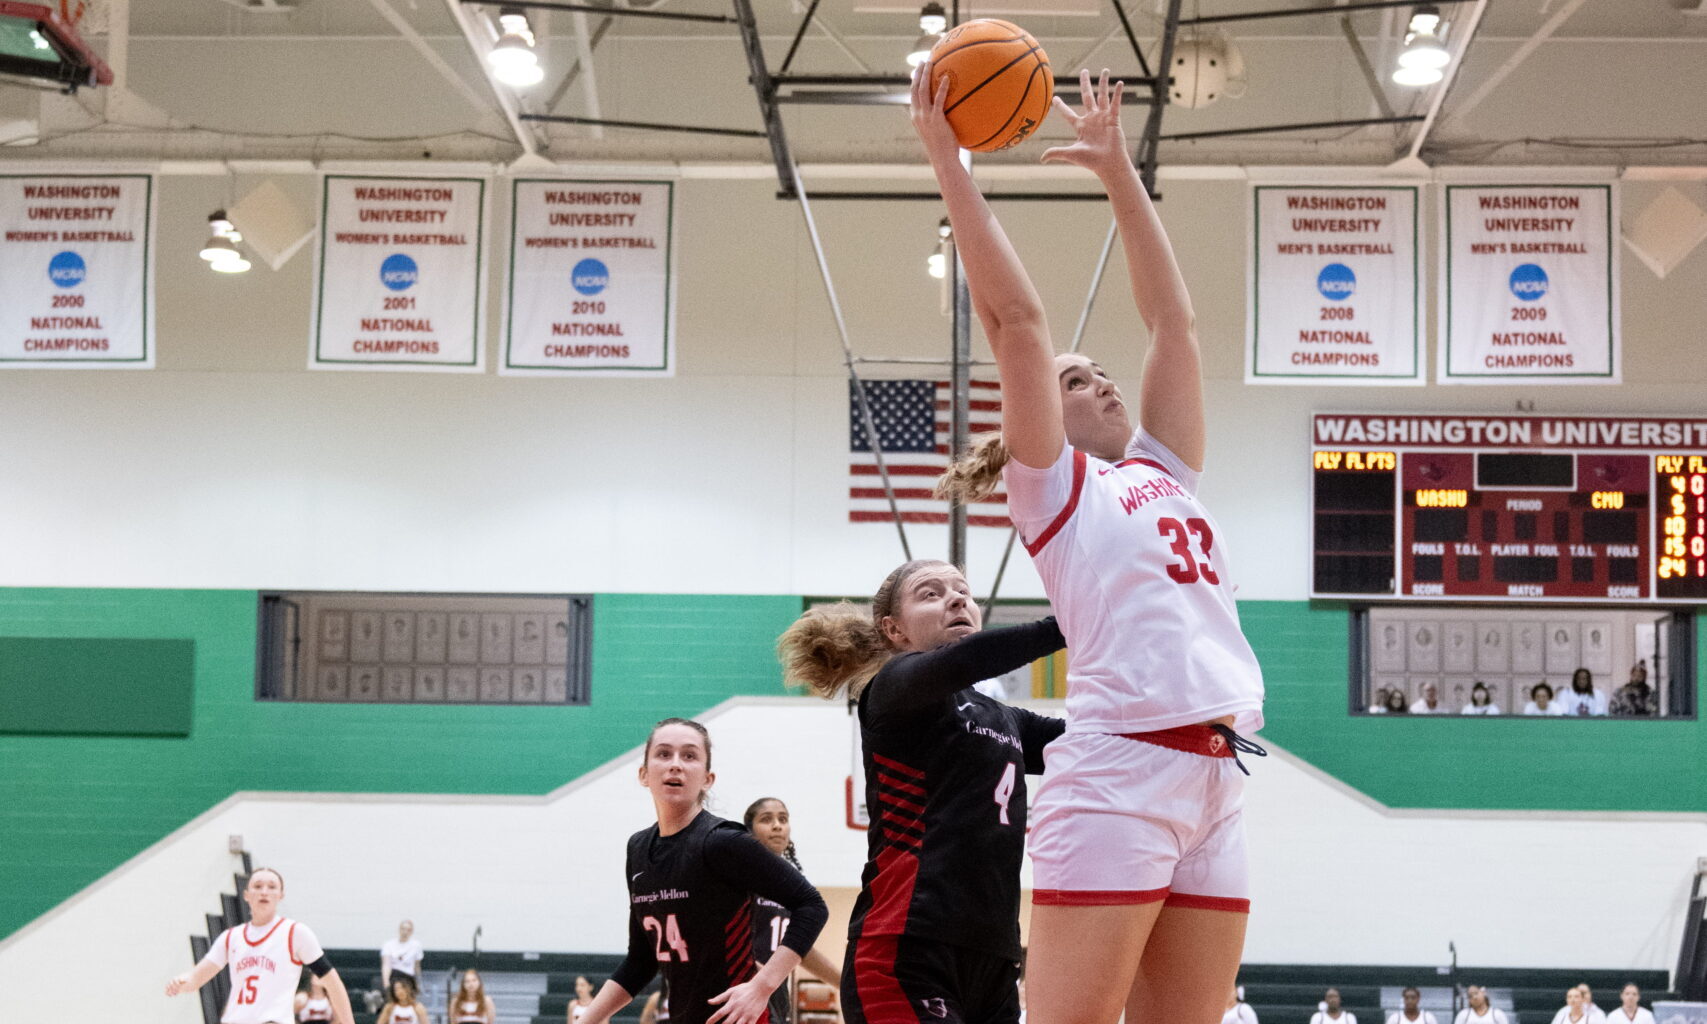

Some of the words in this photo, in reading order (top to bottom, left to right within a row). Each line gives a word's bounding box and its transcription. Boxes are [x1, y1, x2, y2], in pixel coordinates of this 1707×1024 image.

[23, 185, 122, 199] WASHINGTON
[354, 187, 452, 200] WASHINGTON
[544, 192, 641, 204] WASHINGTON
[1287, 197, 1386, 209] WASHINGTON
[1479, 196, 1580, 208] WASHINGTON
[27, 206, 115, 220] UNIVERSITY
[359, 209, 446, 222] UNIVERSITY
[549, 212, 635, 226] UNIVERSITY
[1292, 218, 1381, 232] UNIVERSITY
[1484, 217, 1575, 232] UNIVERSITY
[5, 231, 58, 241] WOMEN'S
[61, 230, 134, 242] BASKETBALL
[336, 232, 390, 244] WOMEN'S
[392, 233, 466, 245] BASKETBALL
[524, 237, 580, 248] WOMEN'S
[582, 237, 655, 248] BASKETBALL
[1276, 243, 1313, 254] MEN'S
[1317, 243, 1392, 255] BASKETBALL
[1471, 242, 1506, 254] MEN'S
[1509, 241, 1588, 254] BASKETBALL
[52, 296, 84, 308] 2000
[384, 297, 416, 310] 2001
[571, 301, 606, 315] 2010
[1320, 307, 1354, 320] 2008
[1511, 307, 1547, 320] 2009
[31, 317, 100, 329] NATIONAL
[360, 318, 432, 332] NATIONAL
[551, 323, 622, 336] NATIONAL
[1299, 330, 1372, 344] NATIONAL
[1492, 332, 1566, 345] NATIONAL
[24, 338, 109, 350] CHAMPIONS
[353, 340, 439, 353] CHAMPIONS
[544, 345, 630, 357] CHAMPIONS
[1291, 352, 1379, 366] CHAMPIONS
[1485, 354, 1574, 368] CHAMPIONS
[1316, 419, 1531, 443] WASHINGTON
[1366, 452, 1396, 470] PTS
[1656, 456, 1684, 473] PLY
[1670, 475, 1687, 494] 4
[1690, 474, 1705, 496] 0
[1416, 489, 1468, 507] WASHU
[1592, 492, 1625, 509] CMU
[1671, 494, 1686, 515] 5
[1697, 496, 1705, 514] 1
[1507, 500, 1543, 511] PERIOD
[1663, 515, 1687, 537] 10
[1697, 517, 1705, 535] 1
[1157, 517, 1220, 586] 33
[1413, 544, 1444, 555] FOULS
[1491, 545, 1528, 556] PLAYER
[1534, 546, 1560, 556] FOUL
[1606, 546, 1639, 557] FOULS
[1664, 535, 1687, 558] 15
[1690, 536, 1705, 557] 0
[1658, 556, 1687, 578] 24
[1697, 559, 1705, 577] 1
[1412, 584, 1444, 596] SCORE
[1508, 585, 1543, 597] MATCH
[1607, 586, 1640, 598] SCORE
[966, 721, 1010, 744] Carnegie
[994, 761, 1017, 825] 4
[659, 888, 689, 900] Mellon
[642, 913, 689, 962] 24
